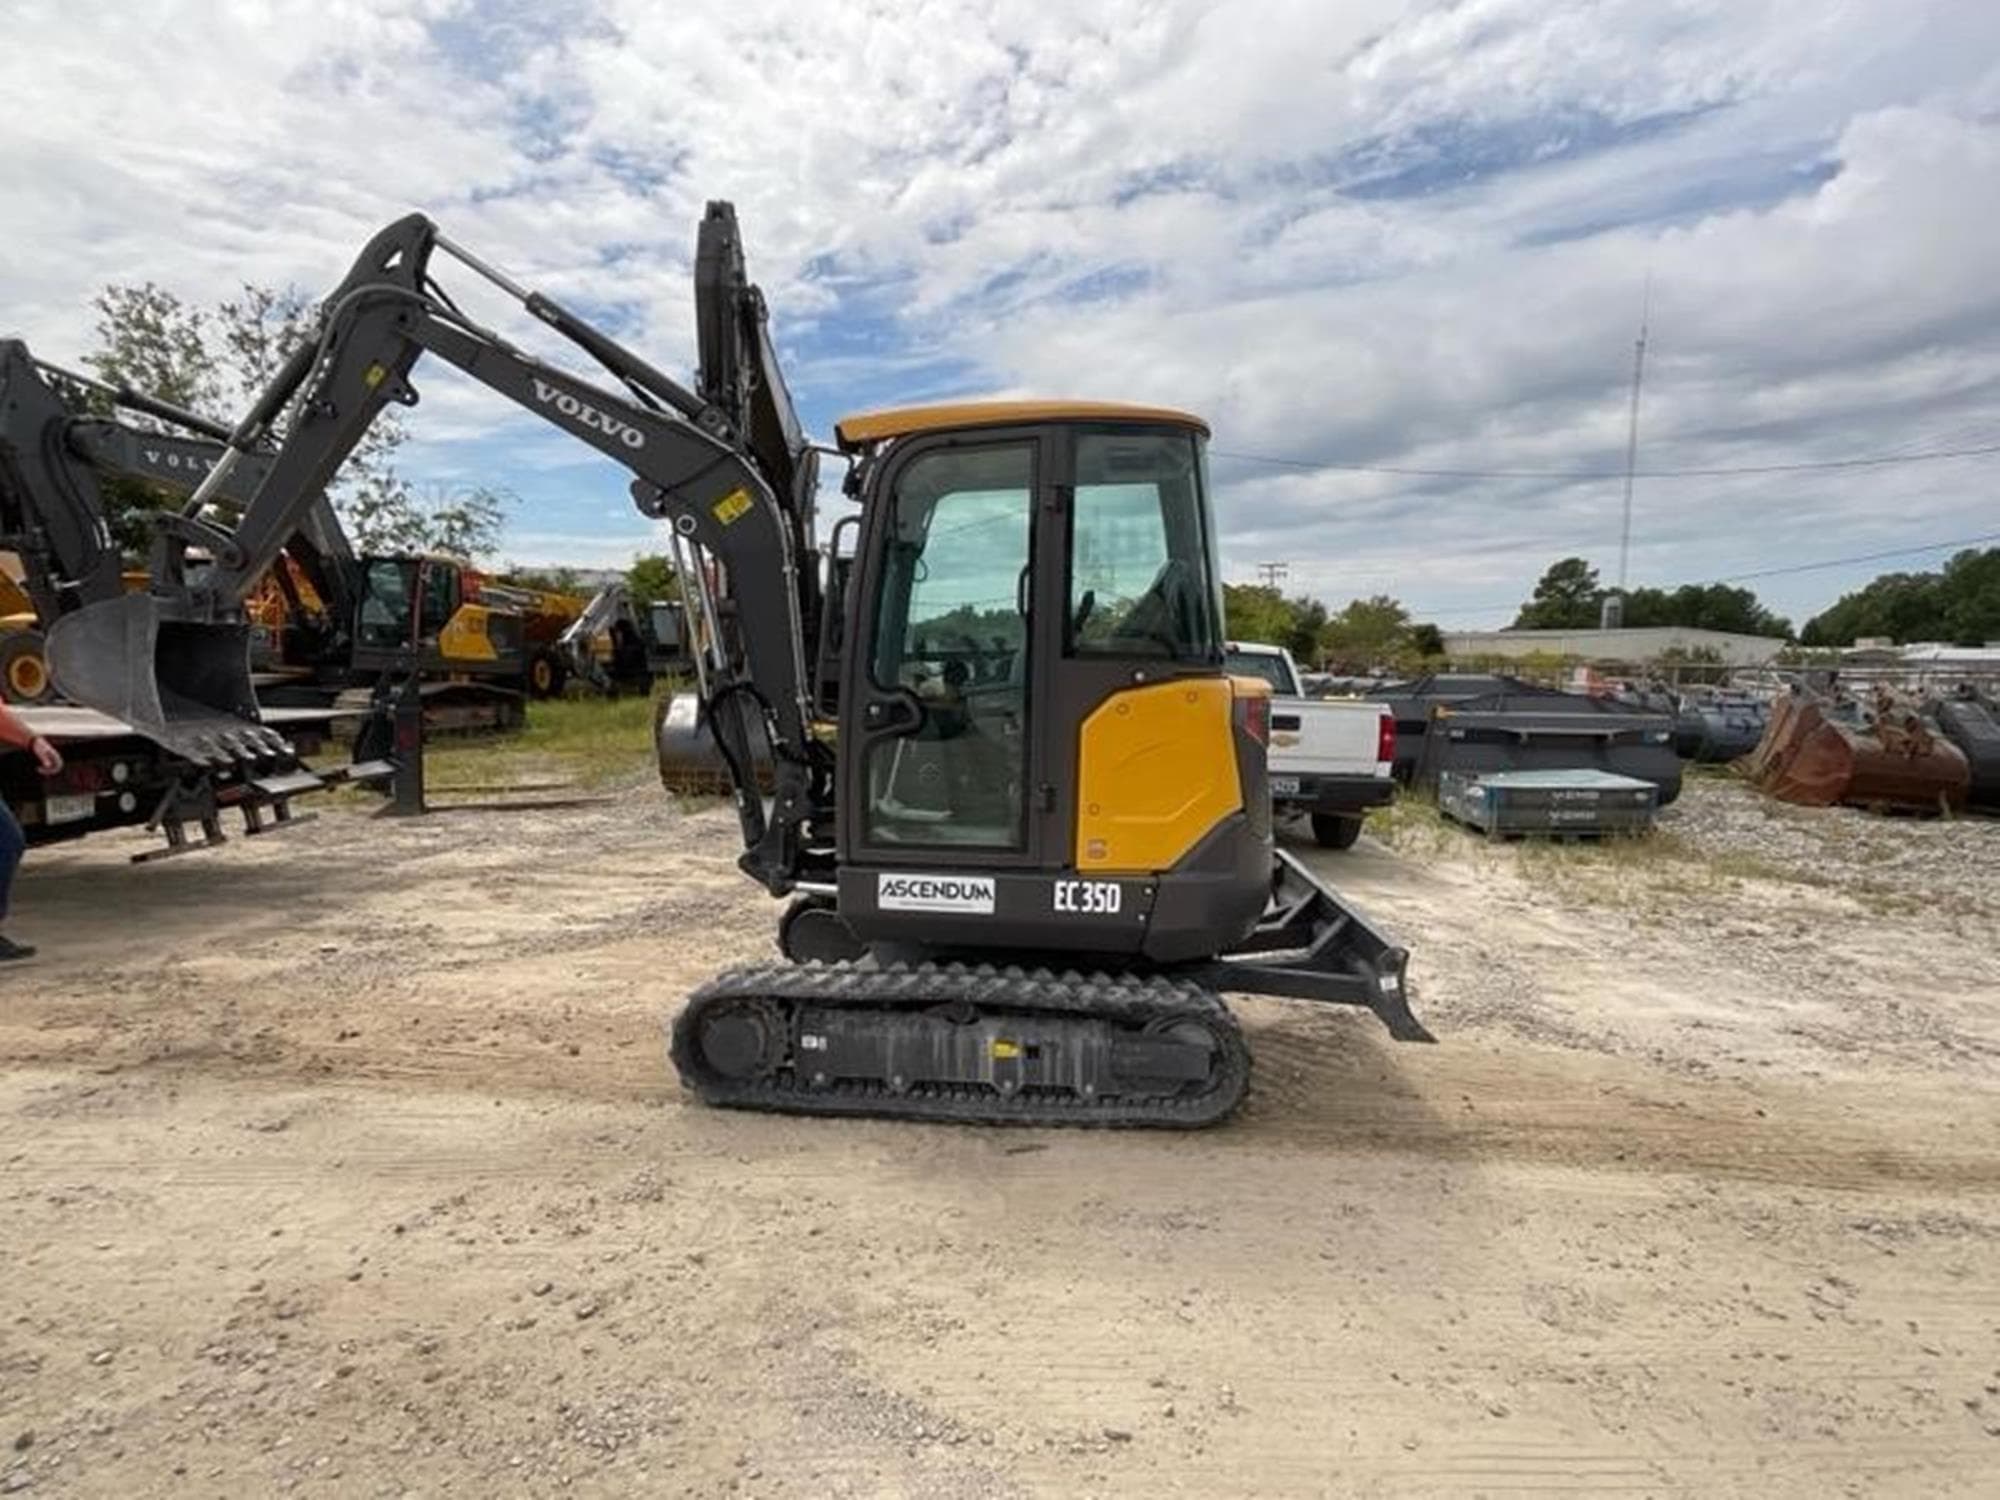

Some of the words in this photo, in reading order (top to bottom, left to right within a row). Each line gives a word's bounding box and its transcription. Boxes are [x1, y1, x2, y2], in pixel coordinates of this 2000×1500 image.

[532, 378, 645, 448] VOLVO
[145, 450, 234, 473] VOLV
[881, 880, 993, 900] ASCENDUM
